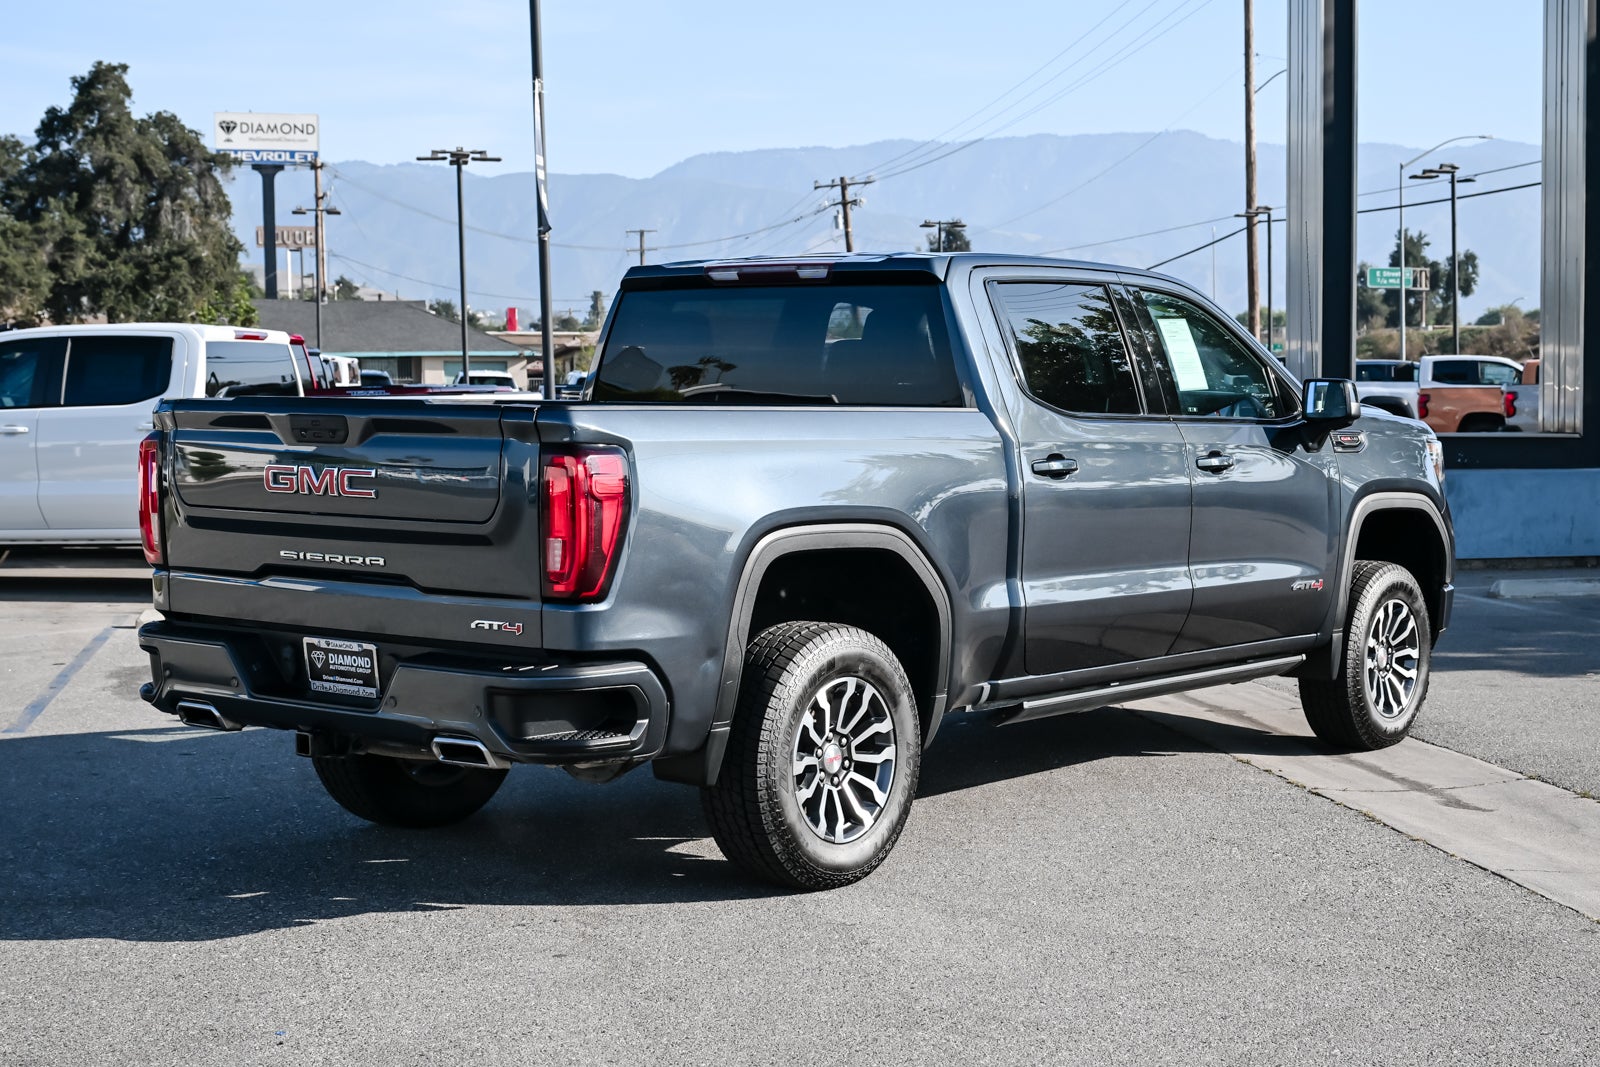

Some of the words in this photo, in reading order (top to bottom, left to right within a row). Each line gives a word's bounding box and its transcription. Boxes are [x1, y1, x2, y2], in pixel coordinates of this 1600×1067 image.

[239, 121, 316, 135] DIAMOND
[263, 464, 378, 499] GMC
[279, 549, 386, 567] SIERRA
[1290, 578, 1324, 591] AT4
[470, 619, 523, 636] AT4
[330, 641, 354, 650] DIAMOND
[328, 653, 371, 668] DIAMOND
